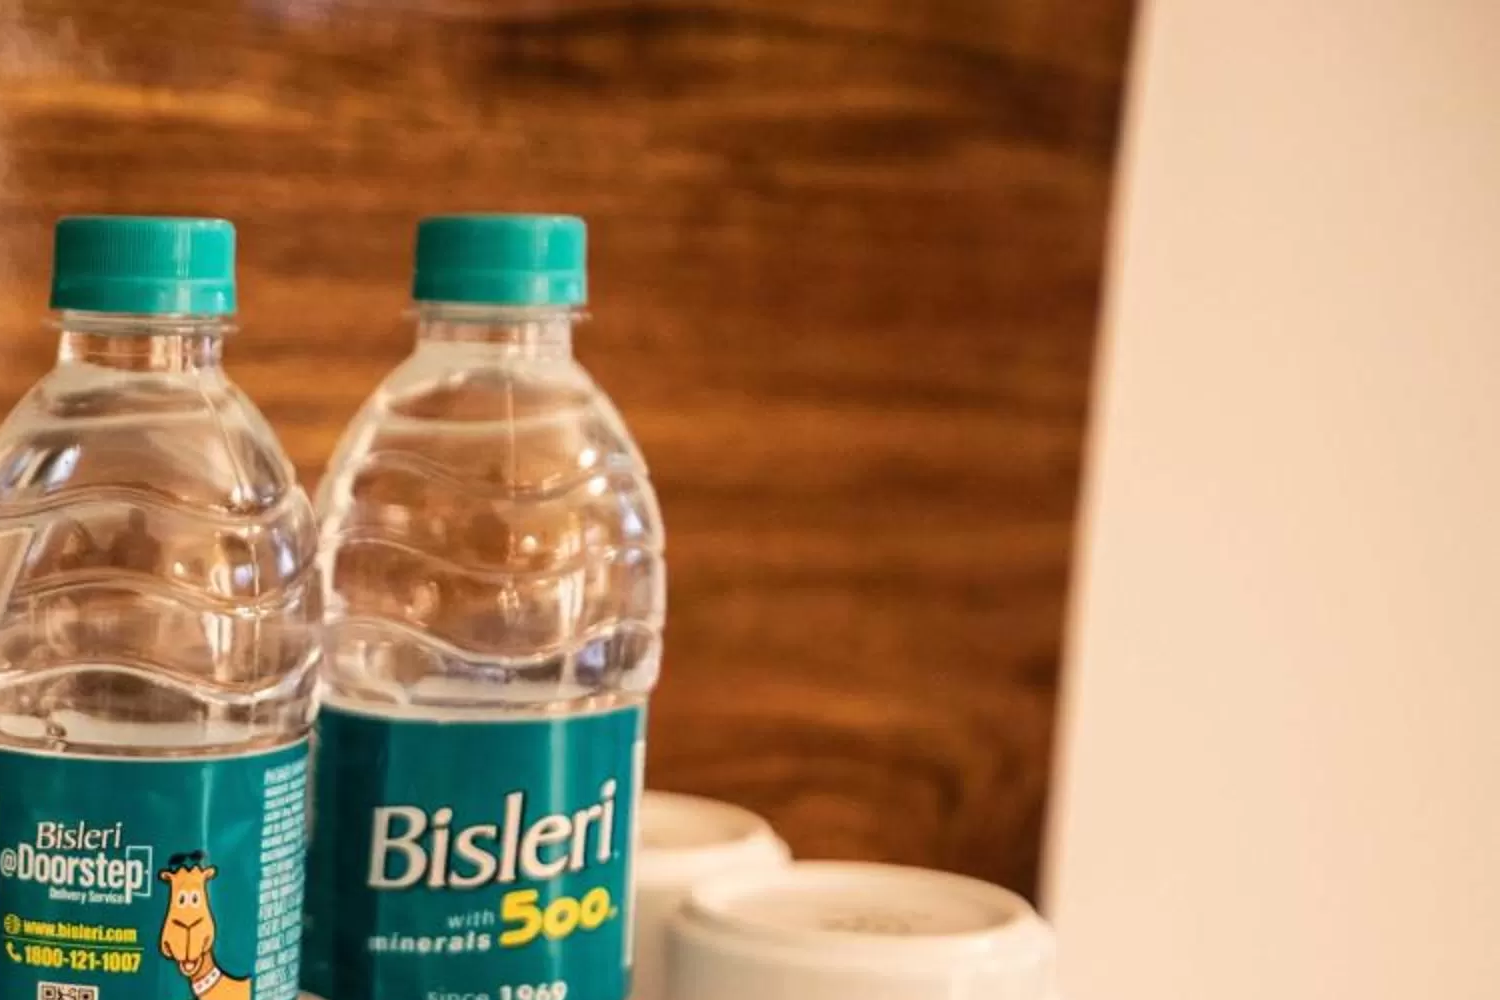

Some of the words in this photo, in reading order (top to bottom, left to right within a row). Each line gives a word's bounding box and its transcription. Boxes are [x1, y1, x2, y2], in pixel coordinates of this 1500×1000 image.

[36, 820, 123, 849] Bisleri
[367, 778, 616, 889] Bisleri
[0, 842, 143, 904] @Doorstep
[23, 919, 137, 942] www.bisleri.com
[447, 909, 495, 930] with
[500, 886, 612, 947] 500
[368, 931, 492, 953] minerals
[24, 944, 141, 973] 1800-121-1007
